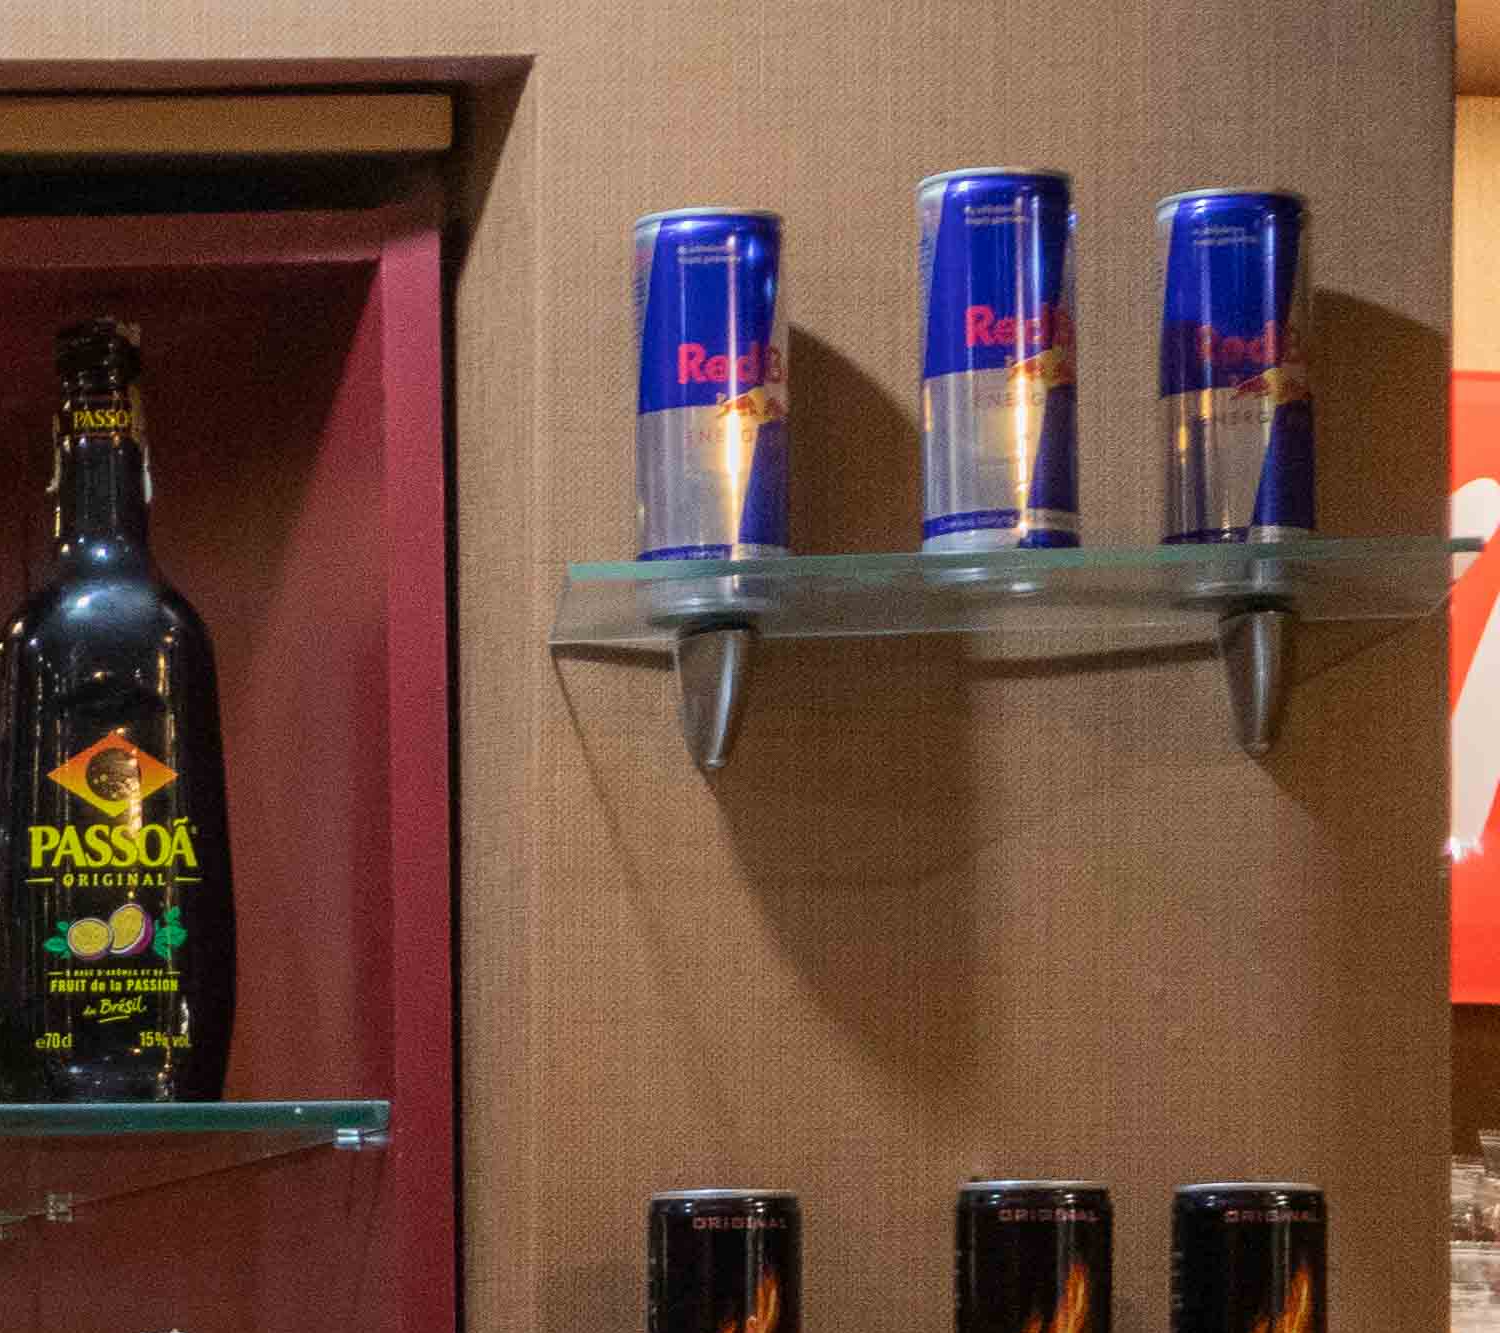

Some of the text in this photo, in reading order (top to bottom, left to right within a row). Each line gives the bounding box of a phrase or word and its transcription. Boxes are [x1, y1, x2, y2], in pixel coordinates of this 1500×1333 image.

[965, 306, 1051, 347] Red
[677, 342, 759, 385] Red
[27, 817, 198, 869] PASSOÃ
[62, 873, 167, 887] ORIGINAL
[50, 979, 179, 993] FRUIT de la PASSION
[690, 1213, 788, 1231] ORIGINAL
[997, 1207, 1099, 1225] ORIGINAL
